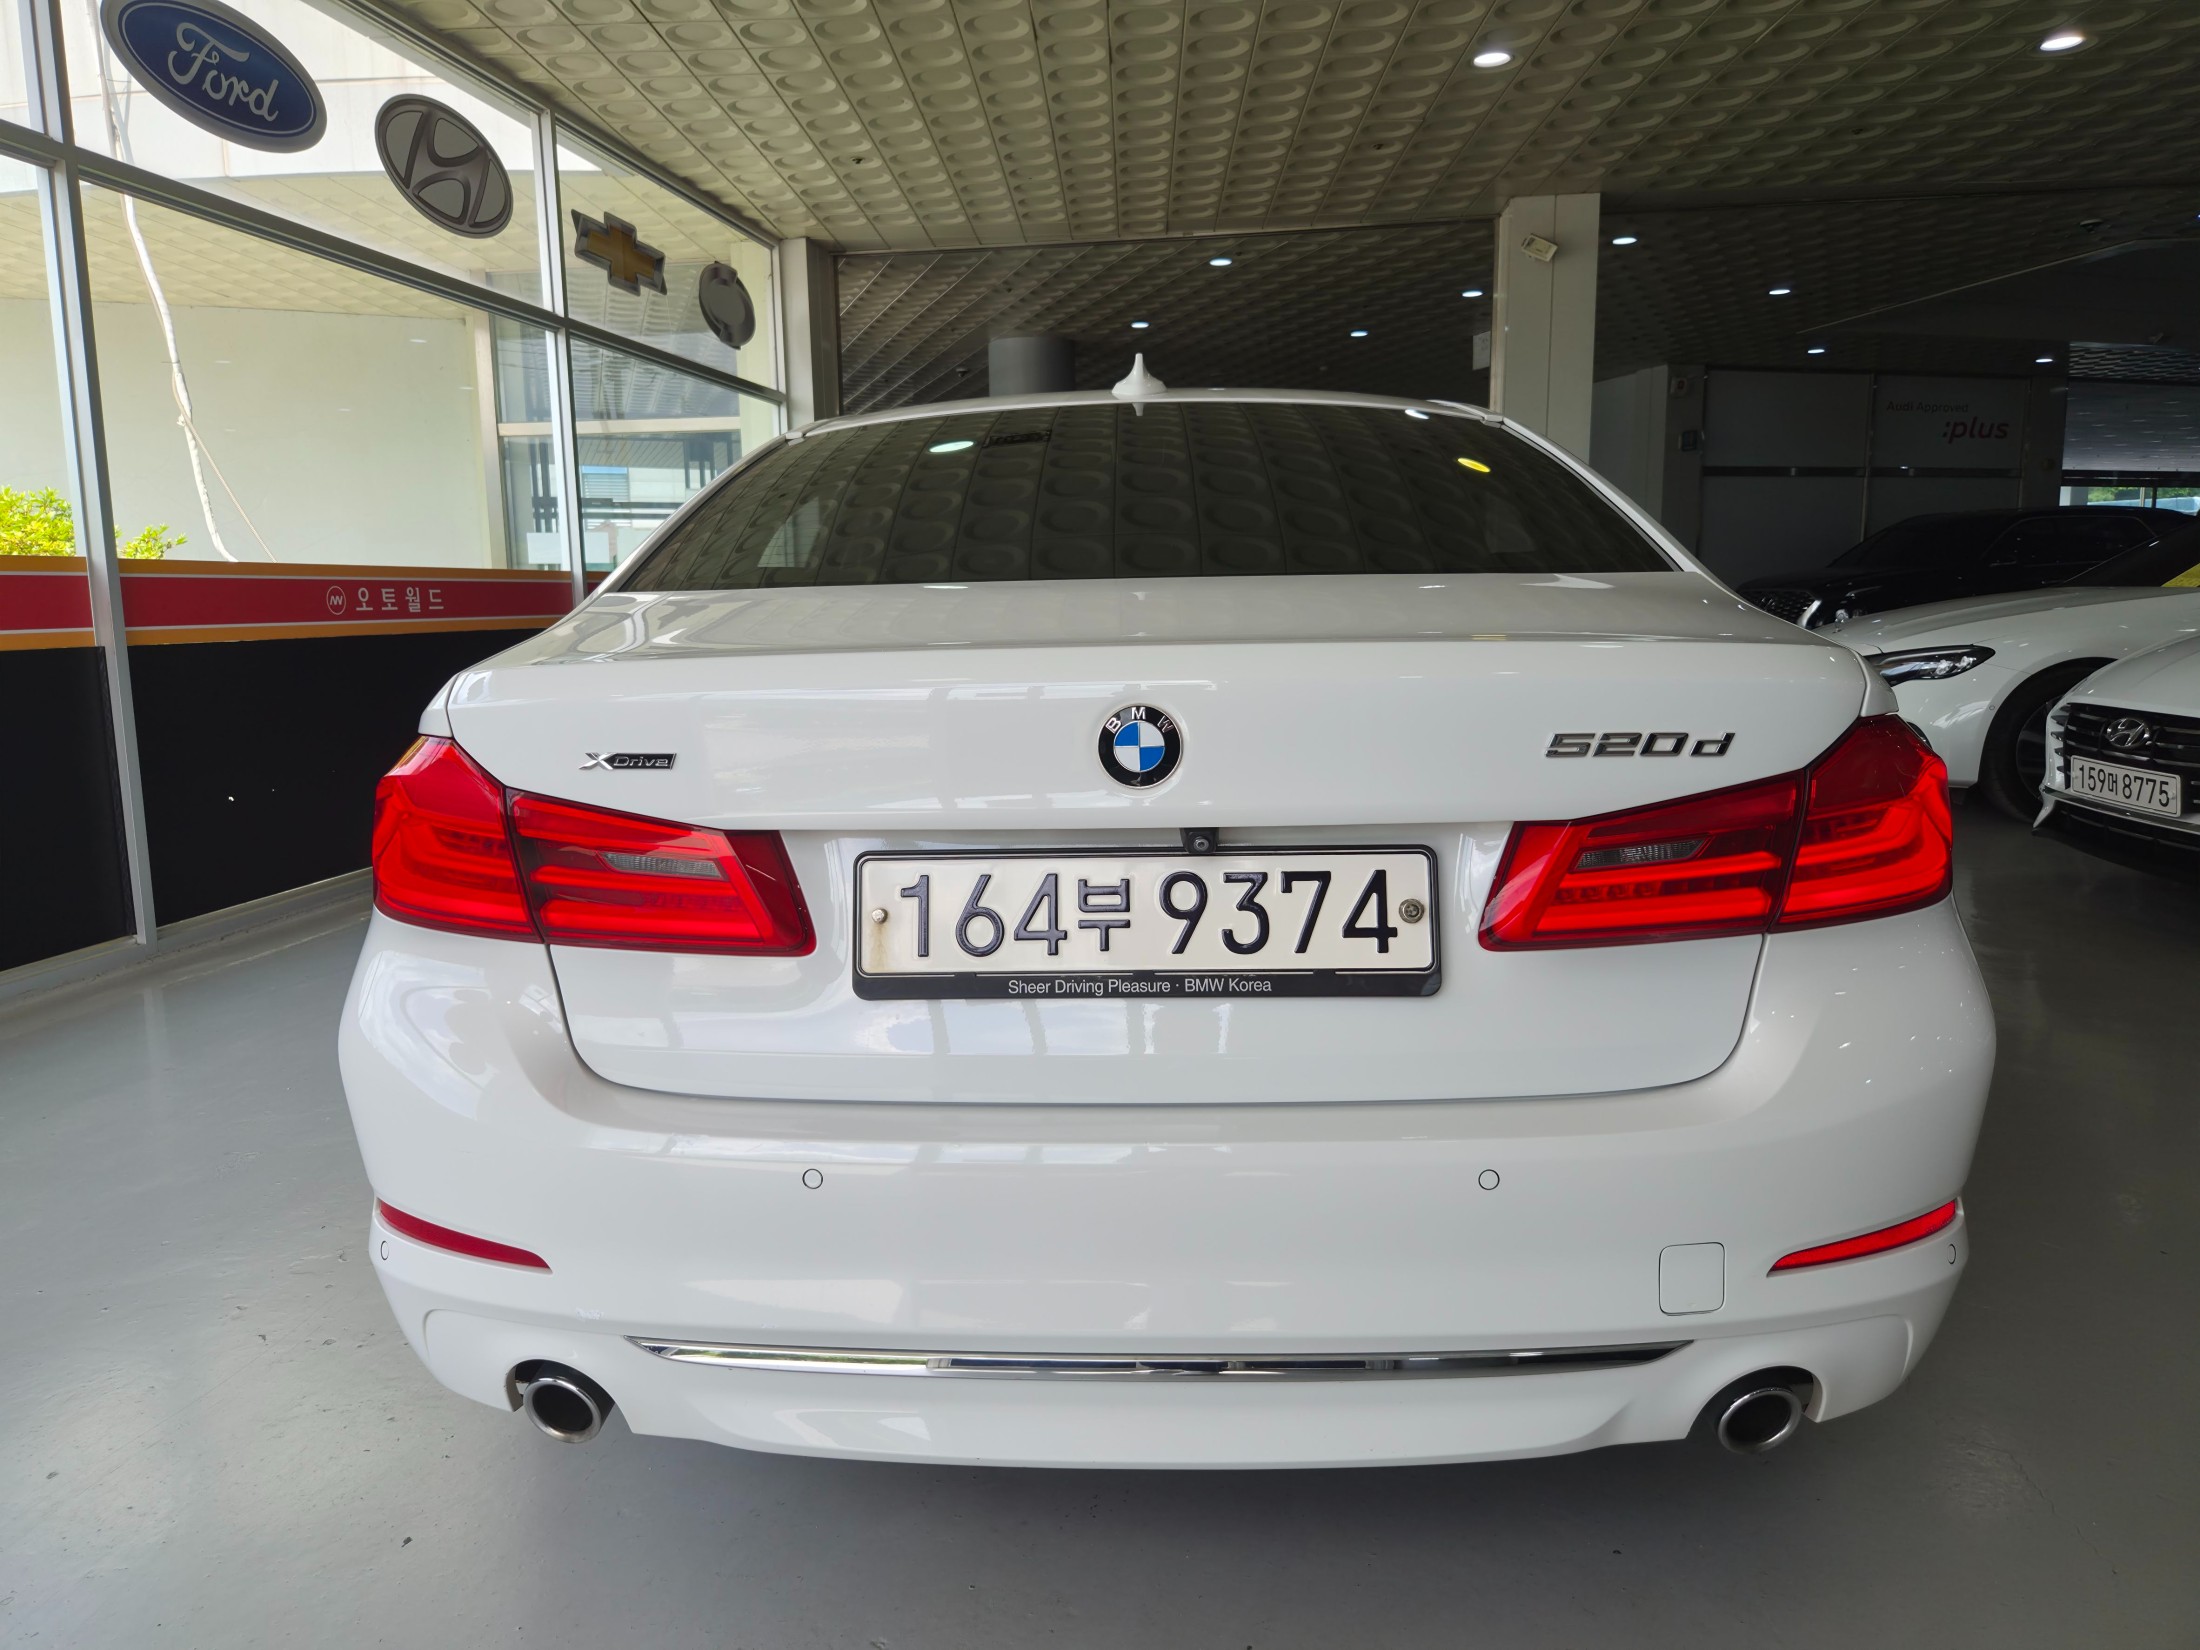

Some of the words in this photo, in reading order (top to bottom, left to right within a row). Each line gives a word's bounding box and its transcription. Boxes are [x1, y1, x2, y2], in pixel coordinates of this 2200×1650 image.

[168, 22, 279, 122] Ford
[1886, 401, 1913, 412] Audi
[1918, 402, 1969, 413] Approved
[355, 586, 445, 613] 오토월드
[1105, 706, 1174, 734] BMW
[1545, 732, 1736, 757] 520d
[1008, 979, 1051, 994] Sheer
[1055, 979, 1104, 996] Driving
[1108, 978, 1171, 993] Pleasure
[1185, 978, 1225, 993] BMW
[1229, 977, 1272, 992] Korea
